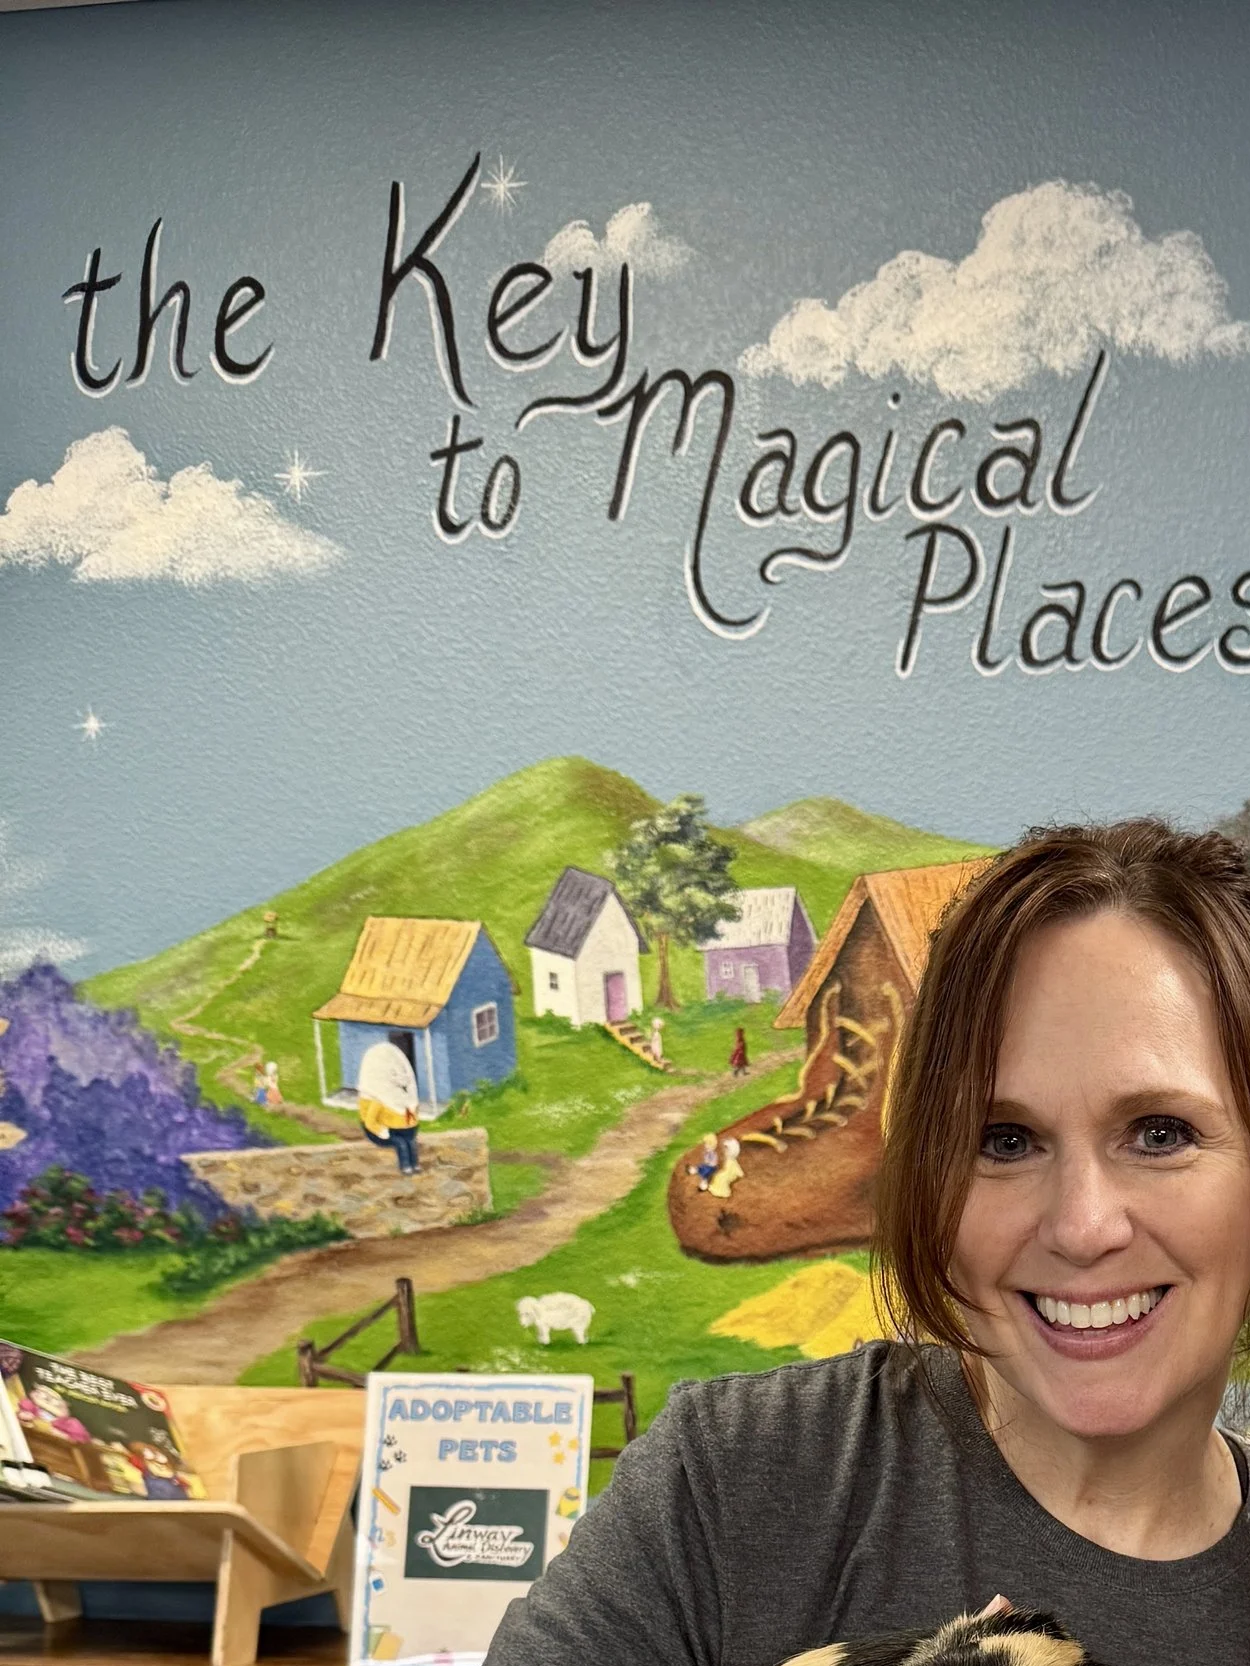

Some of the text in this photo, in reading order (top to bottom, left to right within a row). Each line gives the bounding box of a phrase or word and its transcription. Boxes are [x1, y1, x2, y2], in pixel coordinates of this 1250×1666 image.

[62, 151, 635, 431] the Key
[430, 350, 1107, 640] to Magical
[388, 1398, 574, 1425] ADOPTABLE
[437, 1439, 518, 1462] PETS
[420, 1502, 516, 1562] Linway
